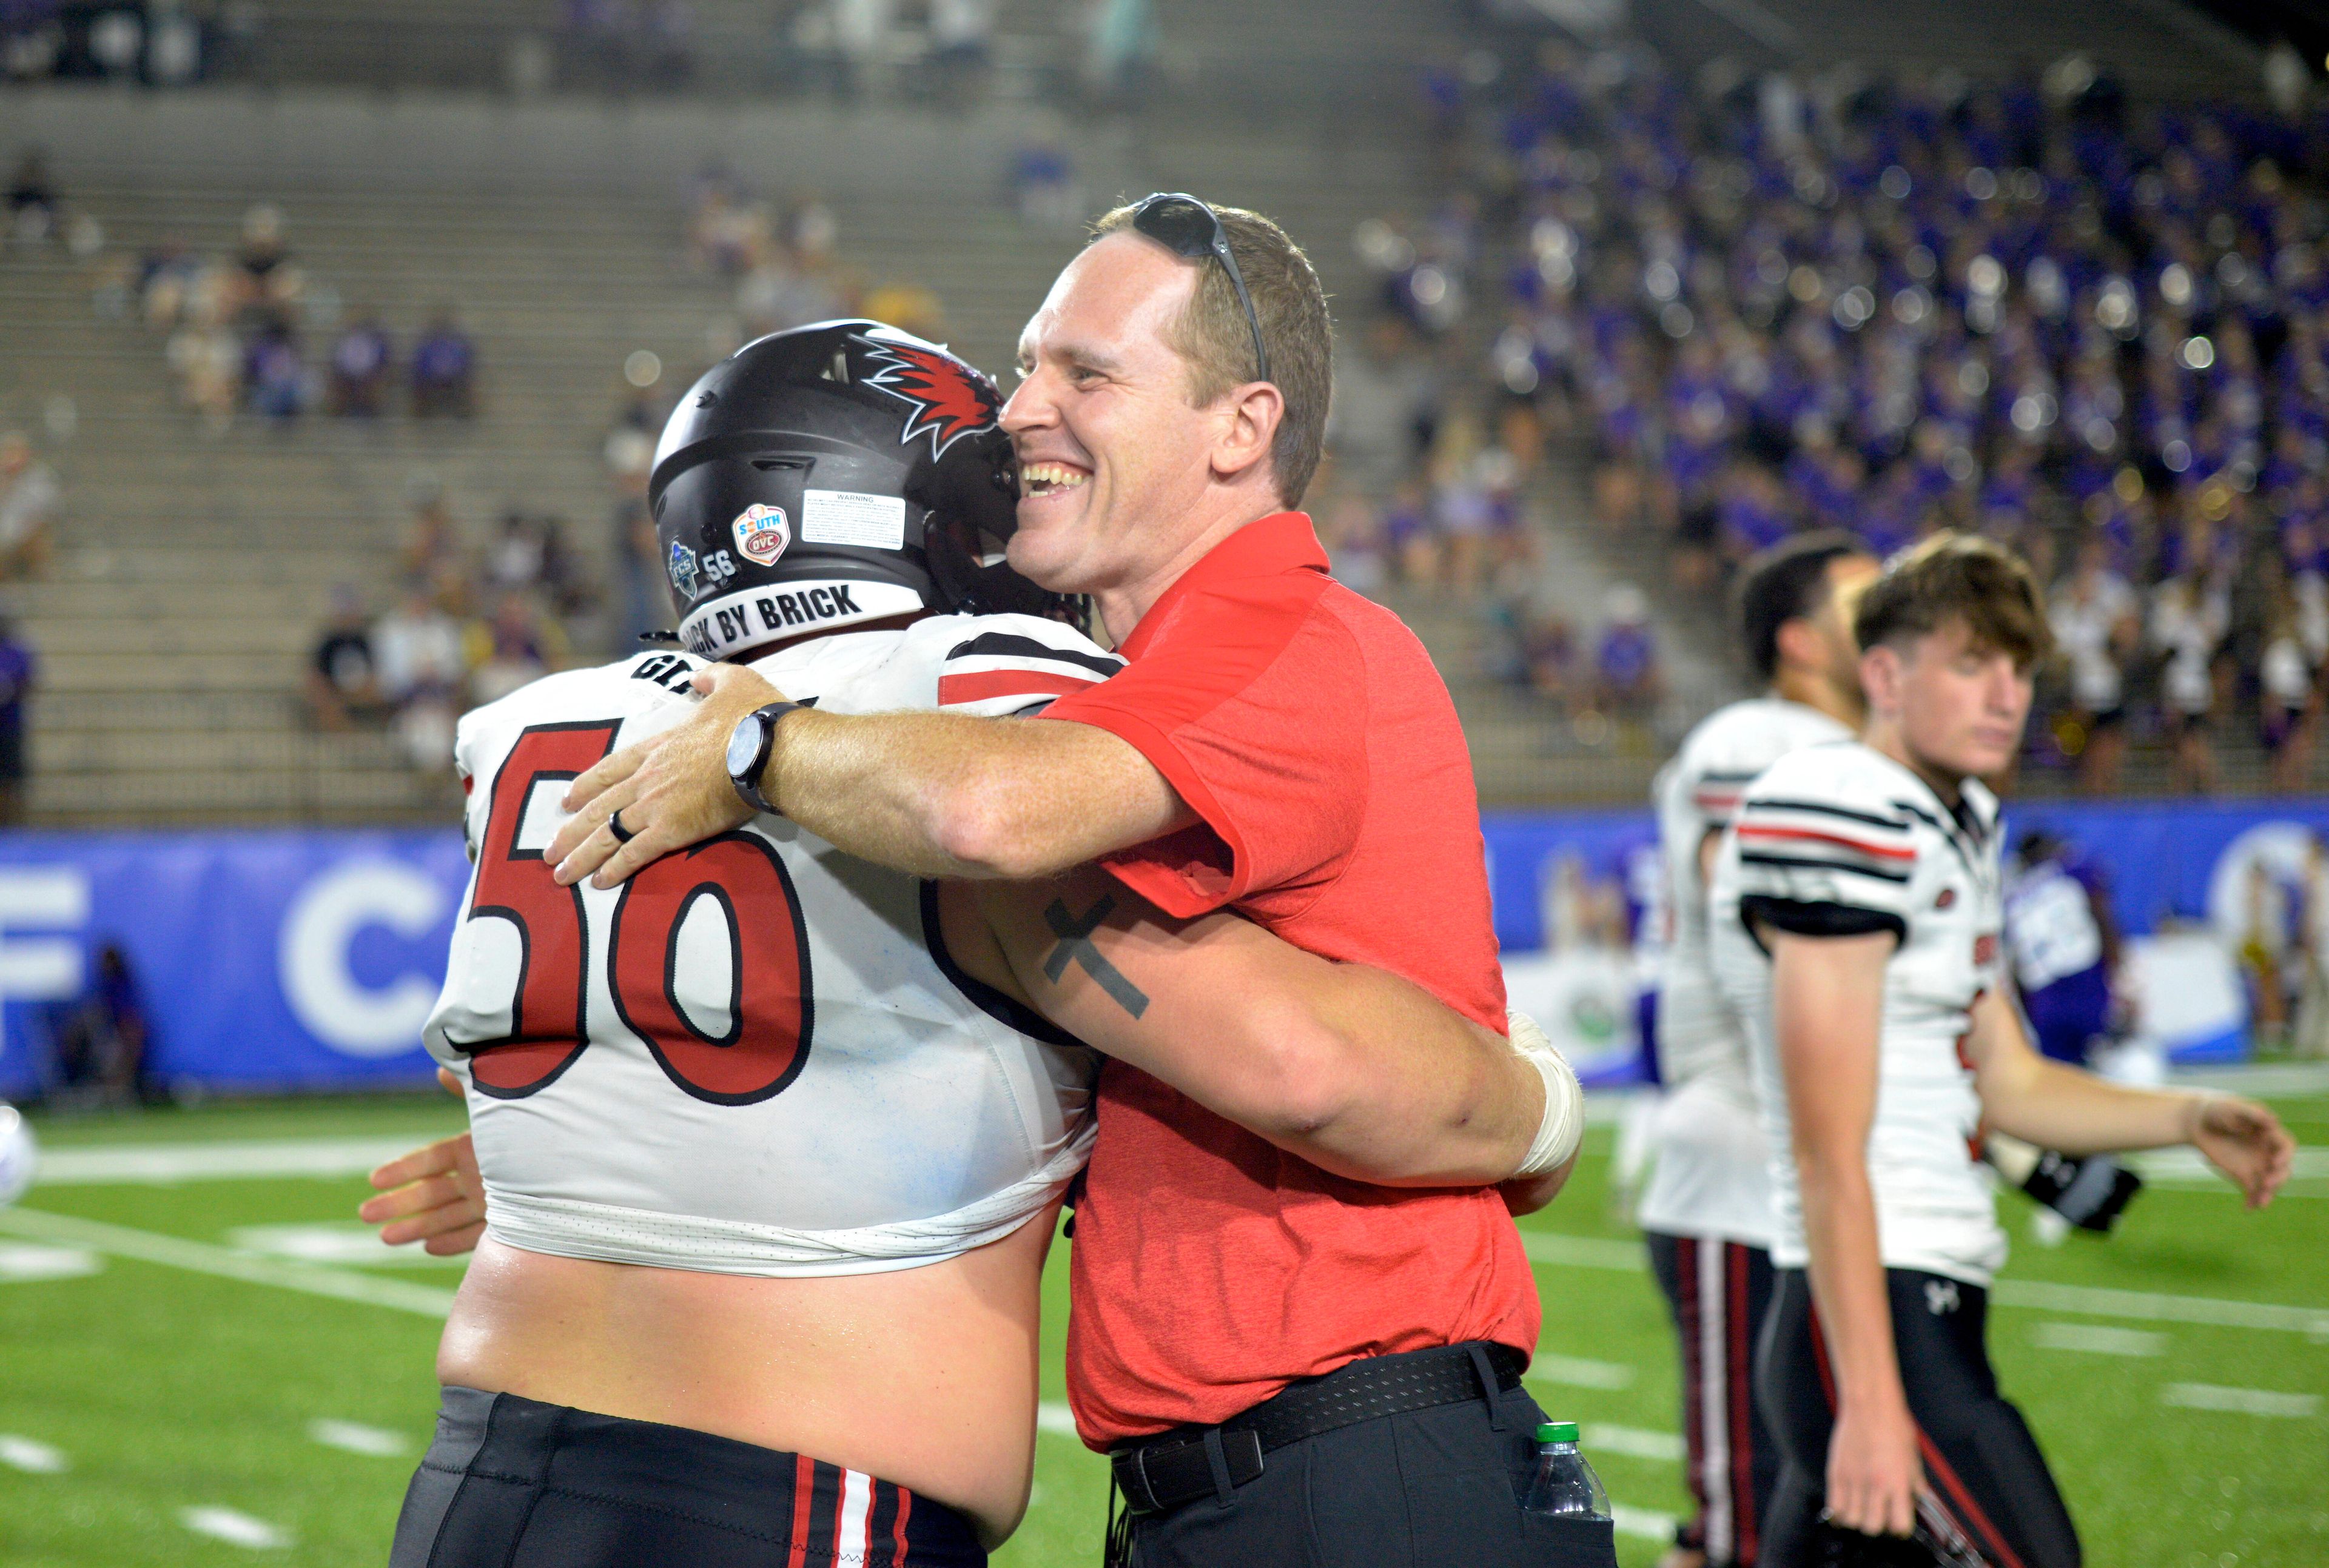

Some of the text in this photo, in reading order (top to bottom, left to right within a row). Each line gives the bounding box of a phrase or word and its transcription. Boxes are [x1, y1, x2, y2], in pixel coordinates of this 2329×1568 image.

[838, 494, 874, 503] WARNING
[739, 514, 781, 535] SOUTH
[753, 535, 775, 551] OVC
[673, 558, 692, 578] FCS
[702, 549, 736, 581] 56
[716, 604, 751, 643] BY
[756, 584, 863, 631] BRICK
[443, 697, 817, 1106] 56
